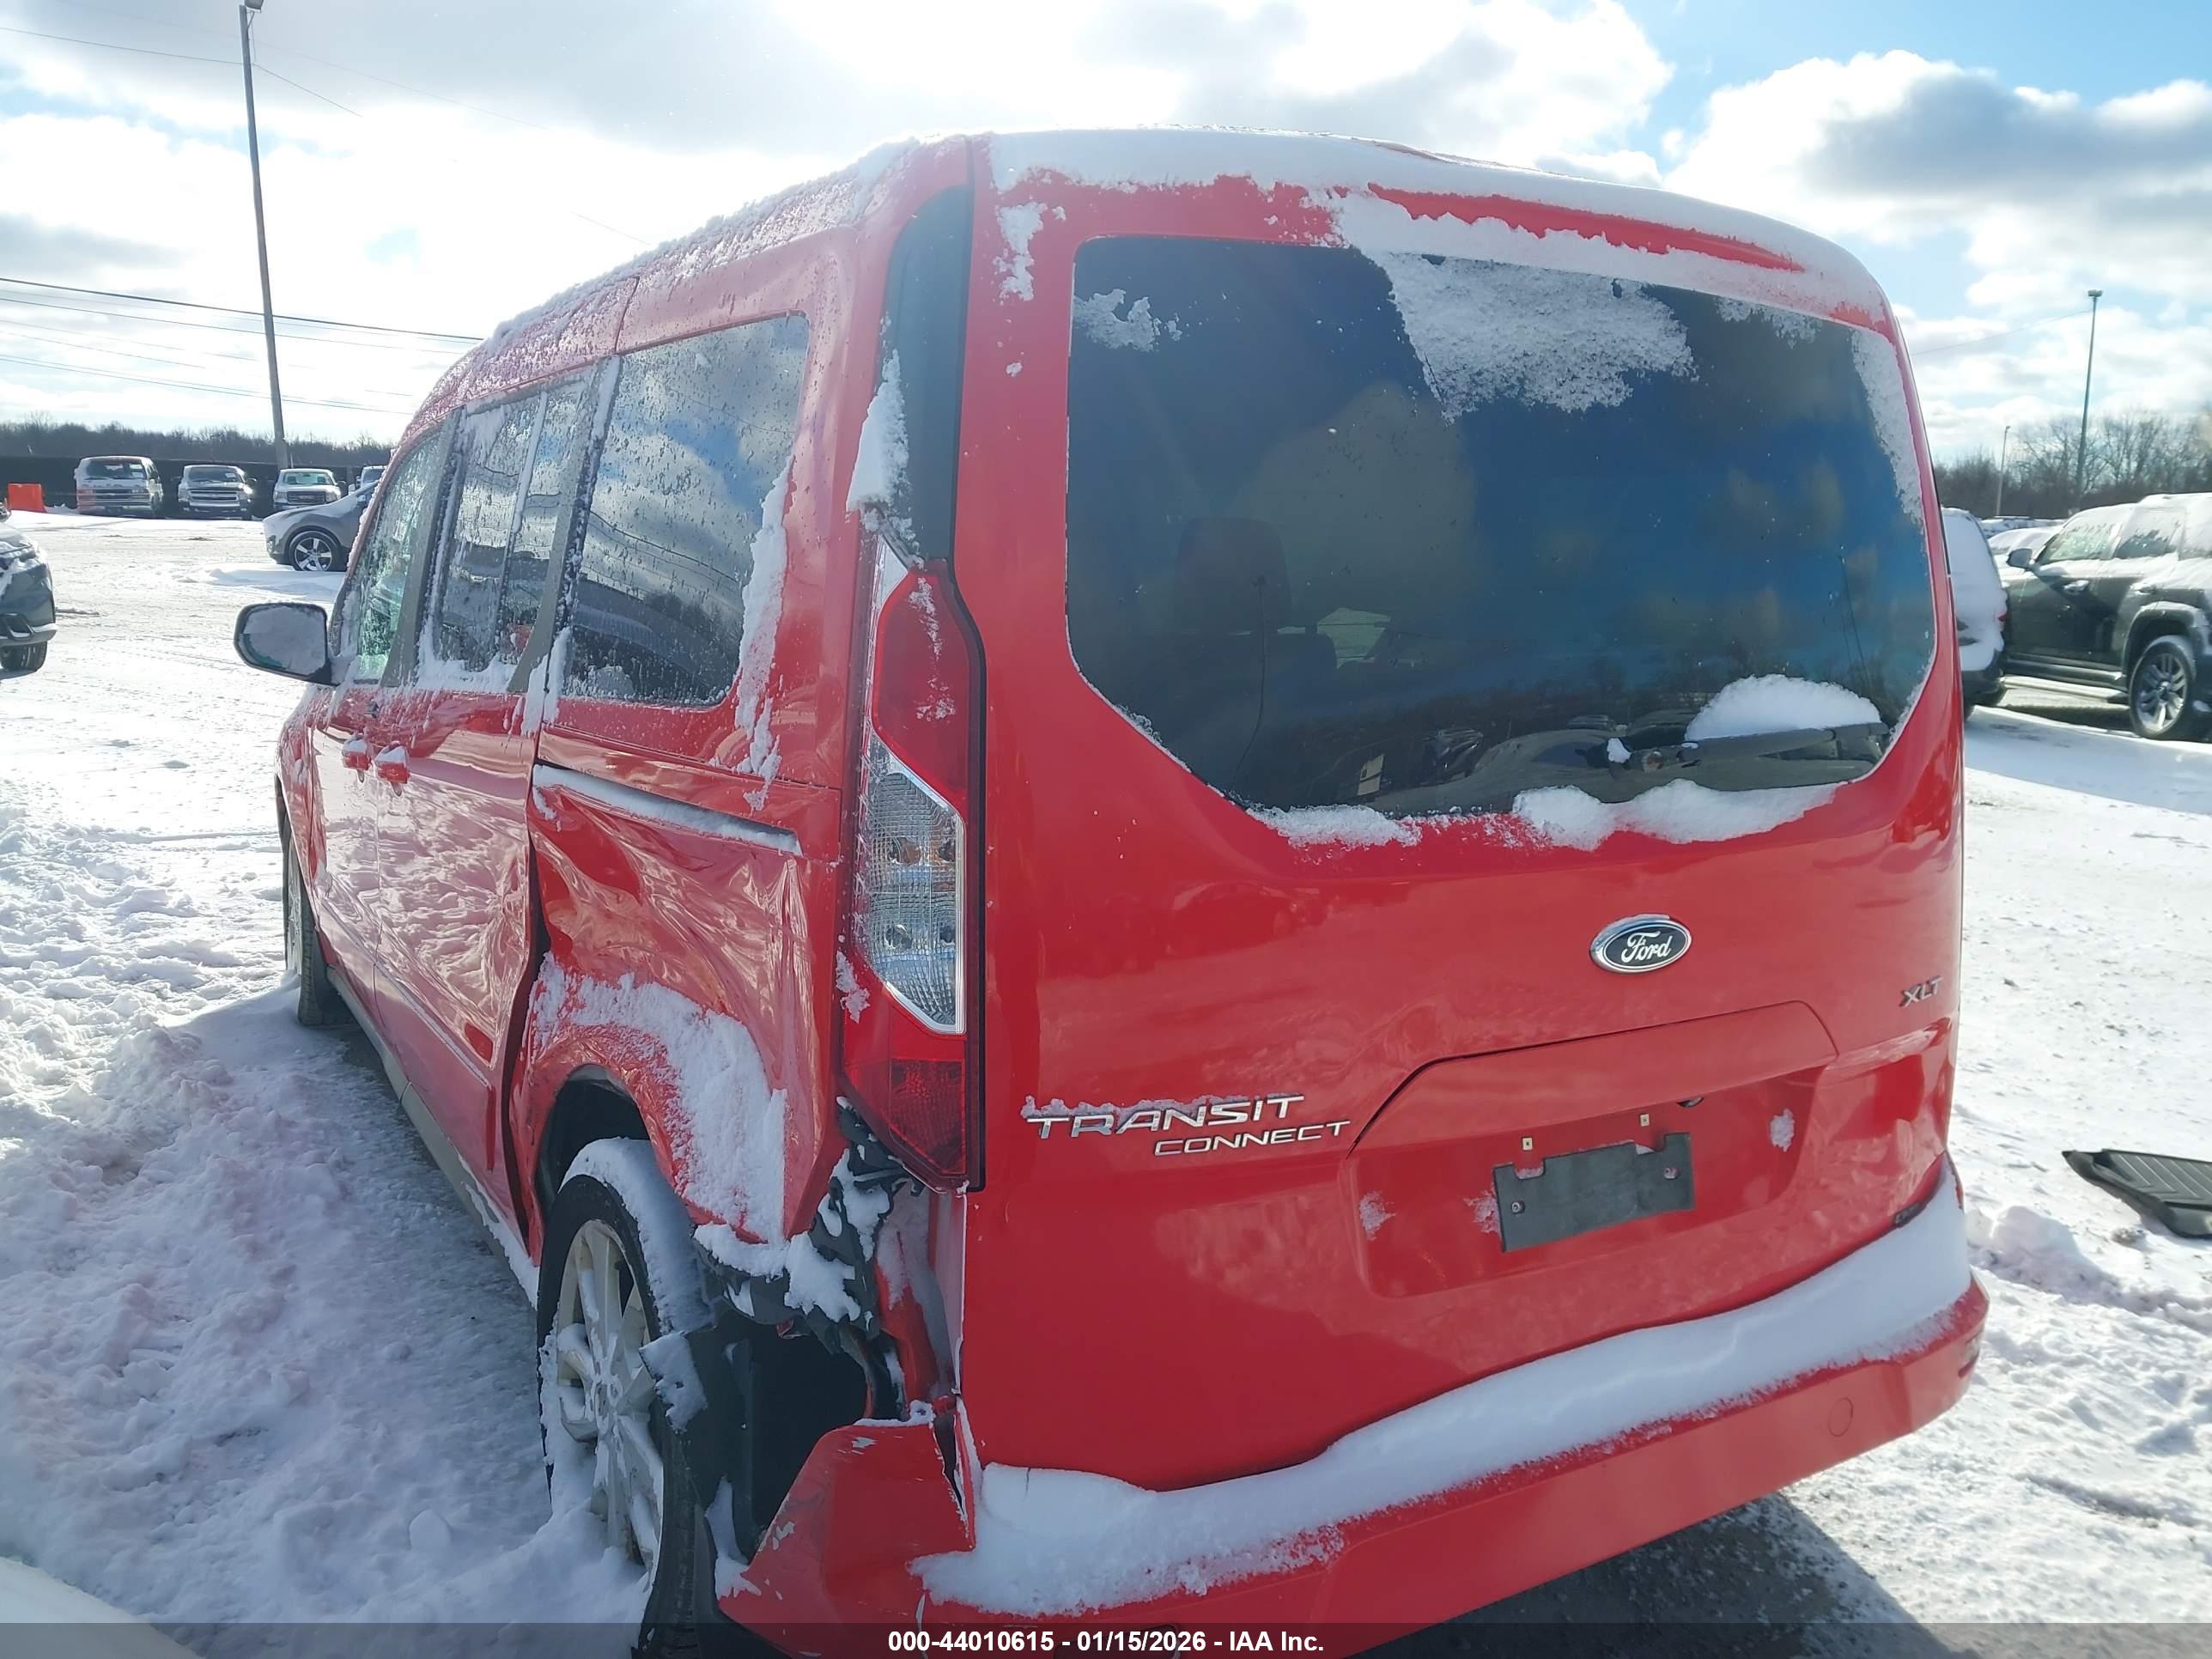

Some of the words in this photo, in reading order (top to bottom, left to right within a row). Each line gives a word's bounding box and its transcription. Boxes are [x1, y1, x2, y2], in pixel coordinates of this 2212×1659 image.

[1620, 931, 1674, 963] Ford
[1900, 976, 1943, 1008] XLT
[1026, 1094, 1305, 1139] TRANSIT
[1153, 1120, 1352, 1157] CONNECT
